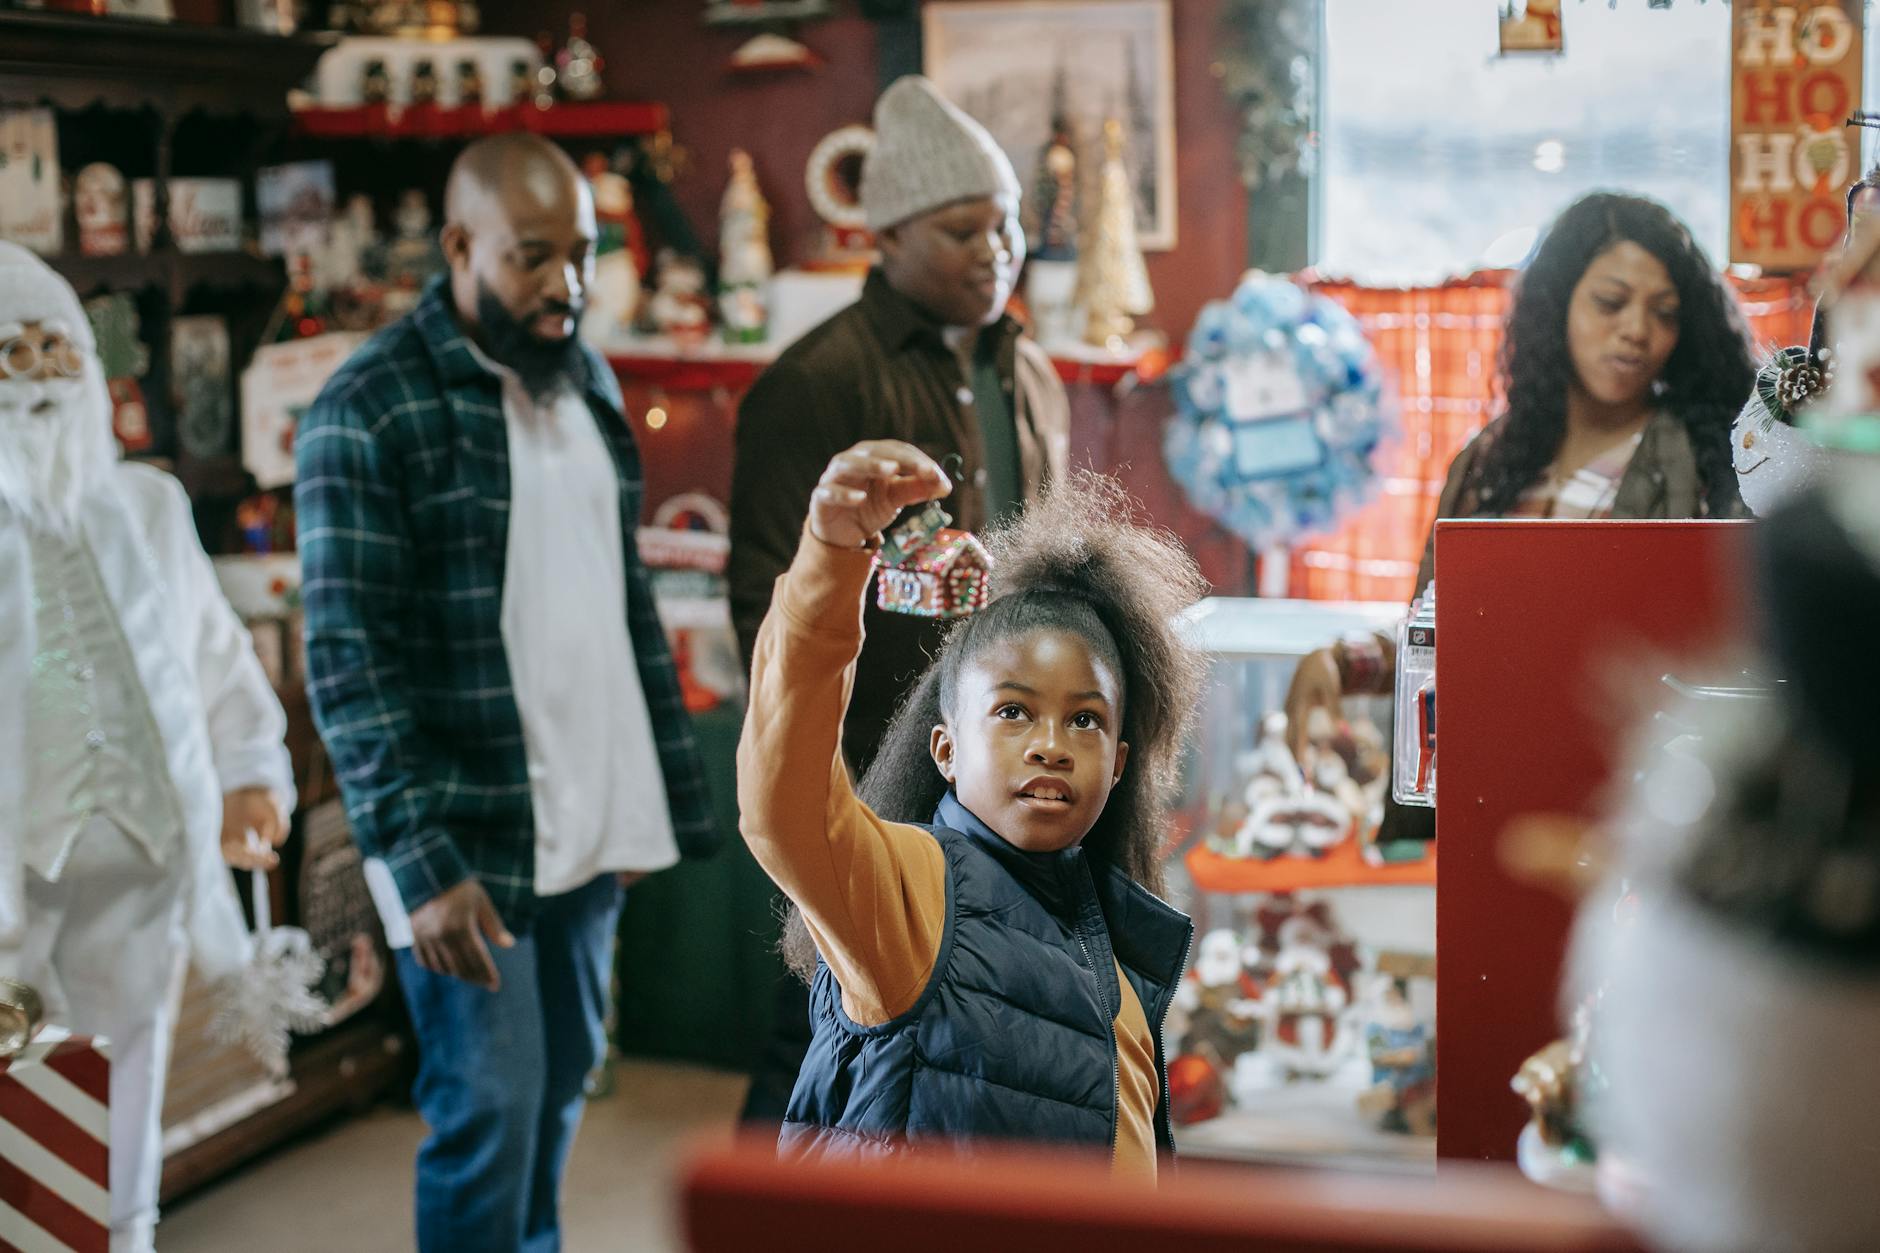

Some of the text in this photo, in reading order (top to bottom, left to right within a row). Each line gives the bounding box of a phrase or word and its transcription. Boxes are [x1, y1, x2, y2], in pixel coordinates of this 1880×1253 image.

[1739, 6, 1852, 66] HO
[1742, 70, 1849, 125] HO
[1738, 130, 1849, 193] HO
[1739, 200, 1846, 249] HO
